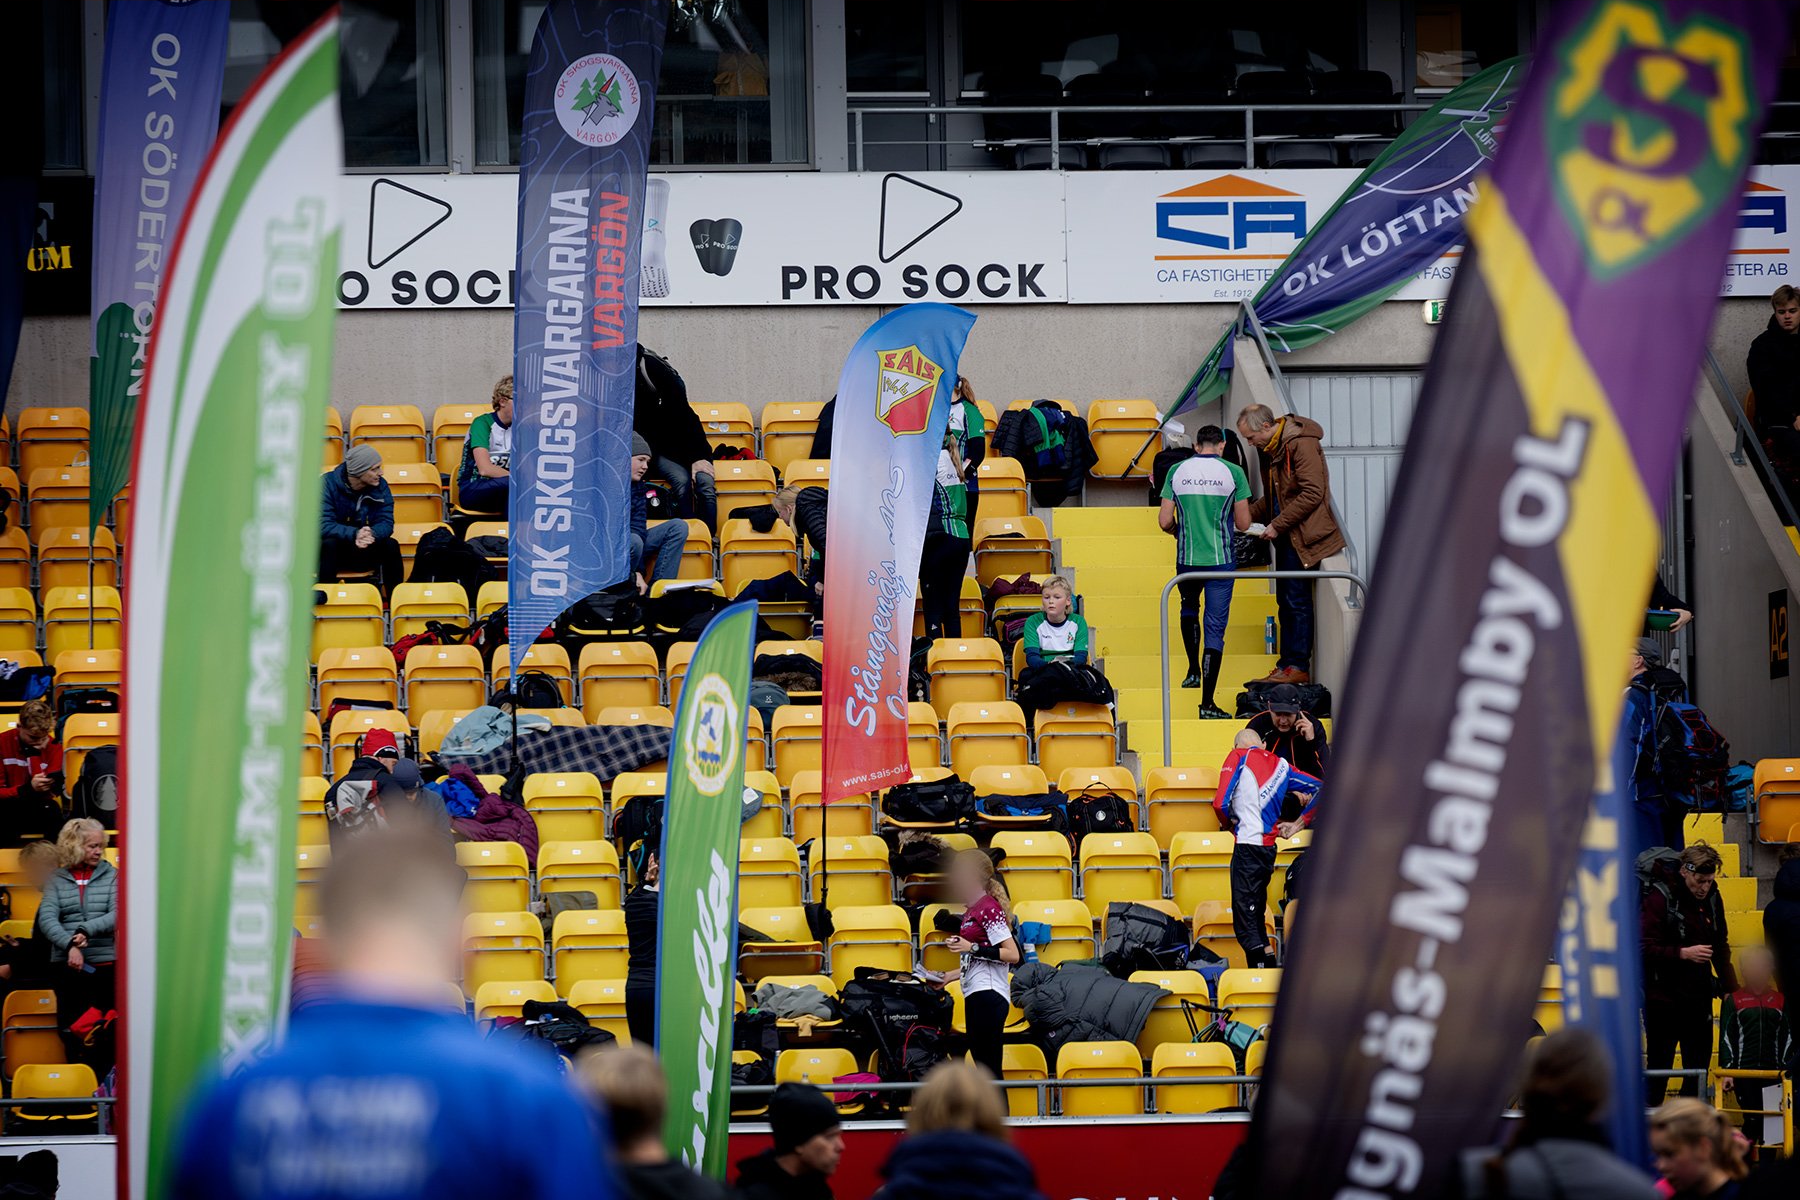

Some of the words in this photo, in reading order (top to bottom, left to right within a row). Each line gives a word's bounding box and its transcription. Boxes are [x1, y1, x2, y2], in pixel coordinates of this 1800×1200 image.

[147, 32, 181, 101] OK
[557, 78, 569, 98] OK
[576, 128, 618, 143] VARGÖN
[1282, 255, 1335, 297] OK
[1341, 181, 1482, 269] LÖFTAN
[591, 191, 629, 350] VARGÖN
[781, 264, 881, 300] PRO
[902, 263, 1048, 299] SOCK
[1156, 269, 1179, 283] CA
[1767, 262, 1789, 276] AB
[1213, 290, 1230, 298] Est.
[1232, 289, 1253, 298] 1912
[534, 187, 590, 532] SKOGSVARGARNA
[884, 349, 936, 381] SAIS
[1181, 478, 1192, 486] OK
[1500, 412, 1591, 548] OL
[530, 543, 570, 597] OK
[1770, 605, 1789, 663] A2
[216, 329, 310, 1082] XHOLM-MJÖLBY
